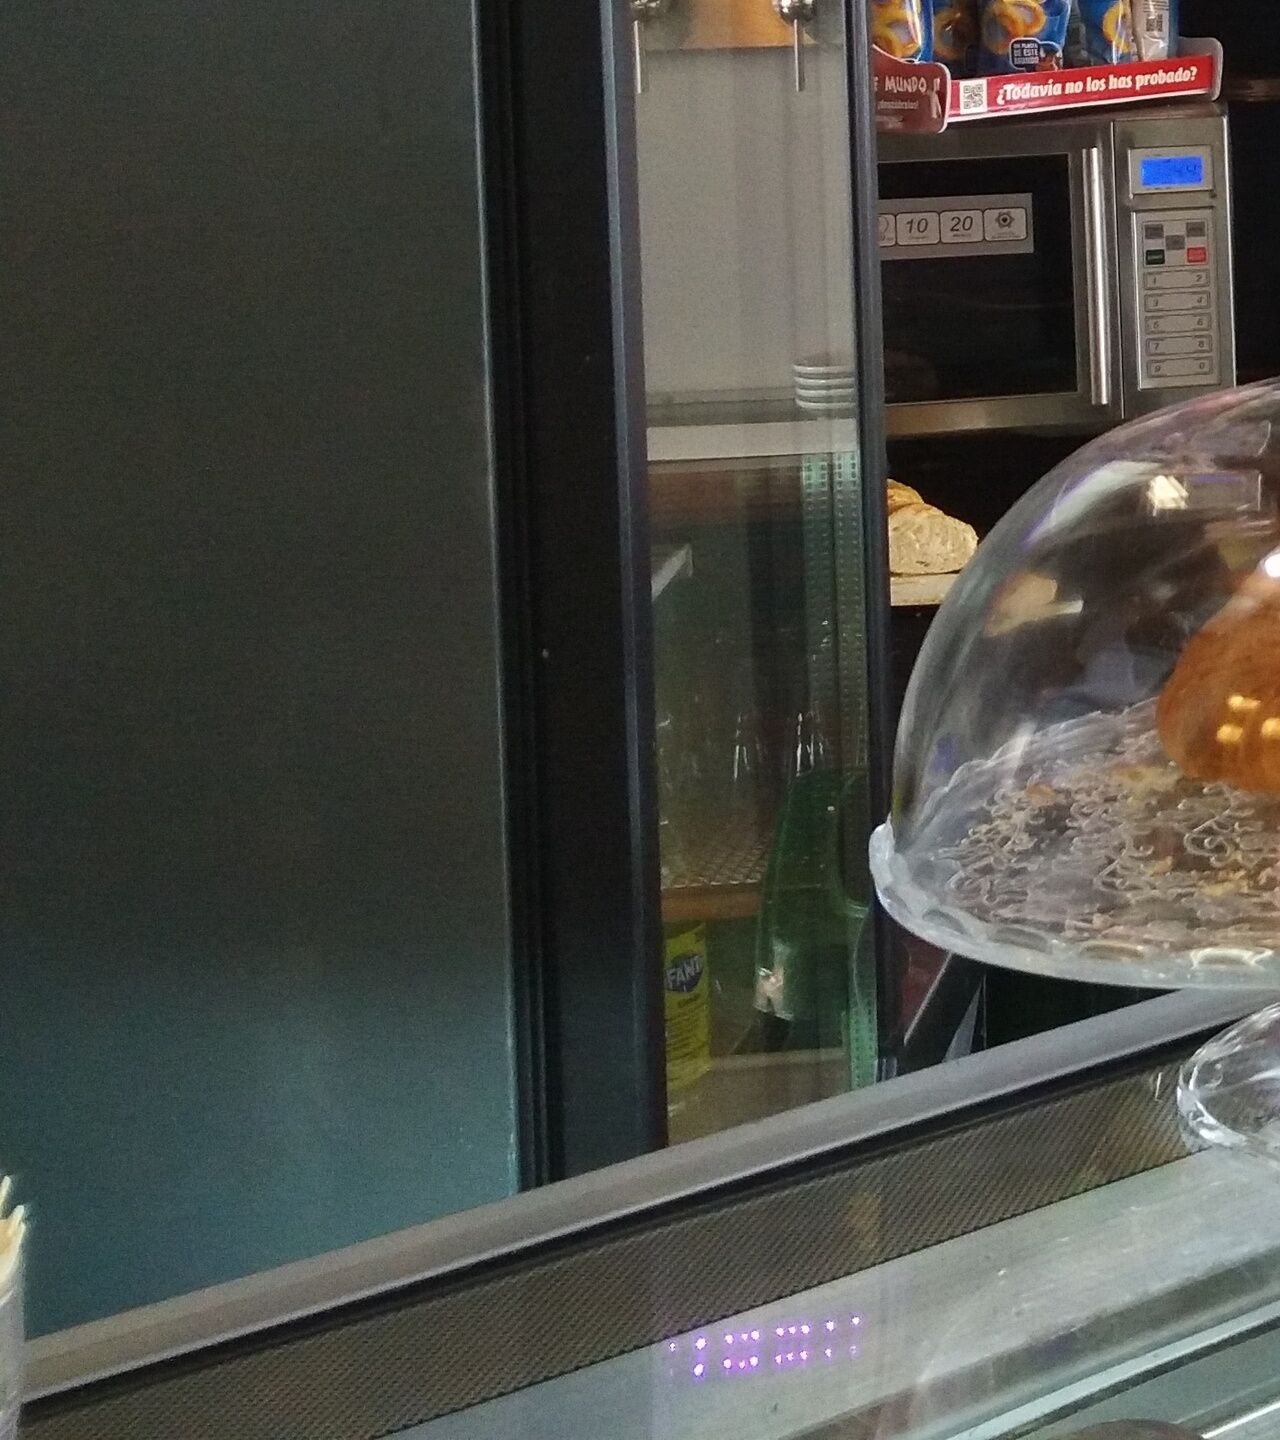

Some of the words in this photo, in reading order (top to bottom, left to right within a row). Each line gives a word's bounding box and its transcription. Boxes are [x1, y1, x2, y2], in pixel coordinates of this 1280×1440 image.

[996, 75, 1063, 105] ¿Todavía
[1065, 80, 1083, 95] no
[1086, 75, 1106, 92] los
[1108, 73, 1133, 90] has
[1135, 65, 1198, 91] probado?
[905, 217, 929, 234] 10
[950, 215, 974, 233] 20
